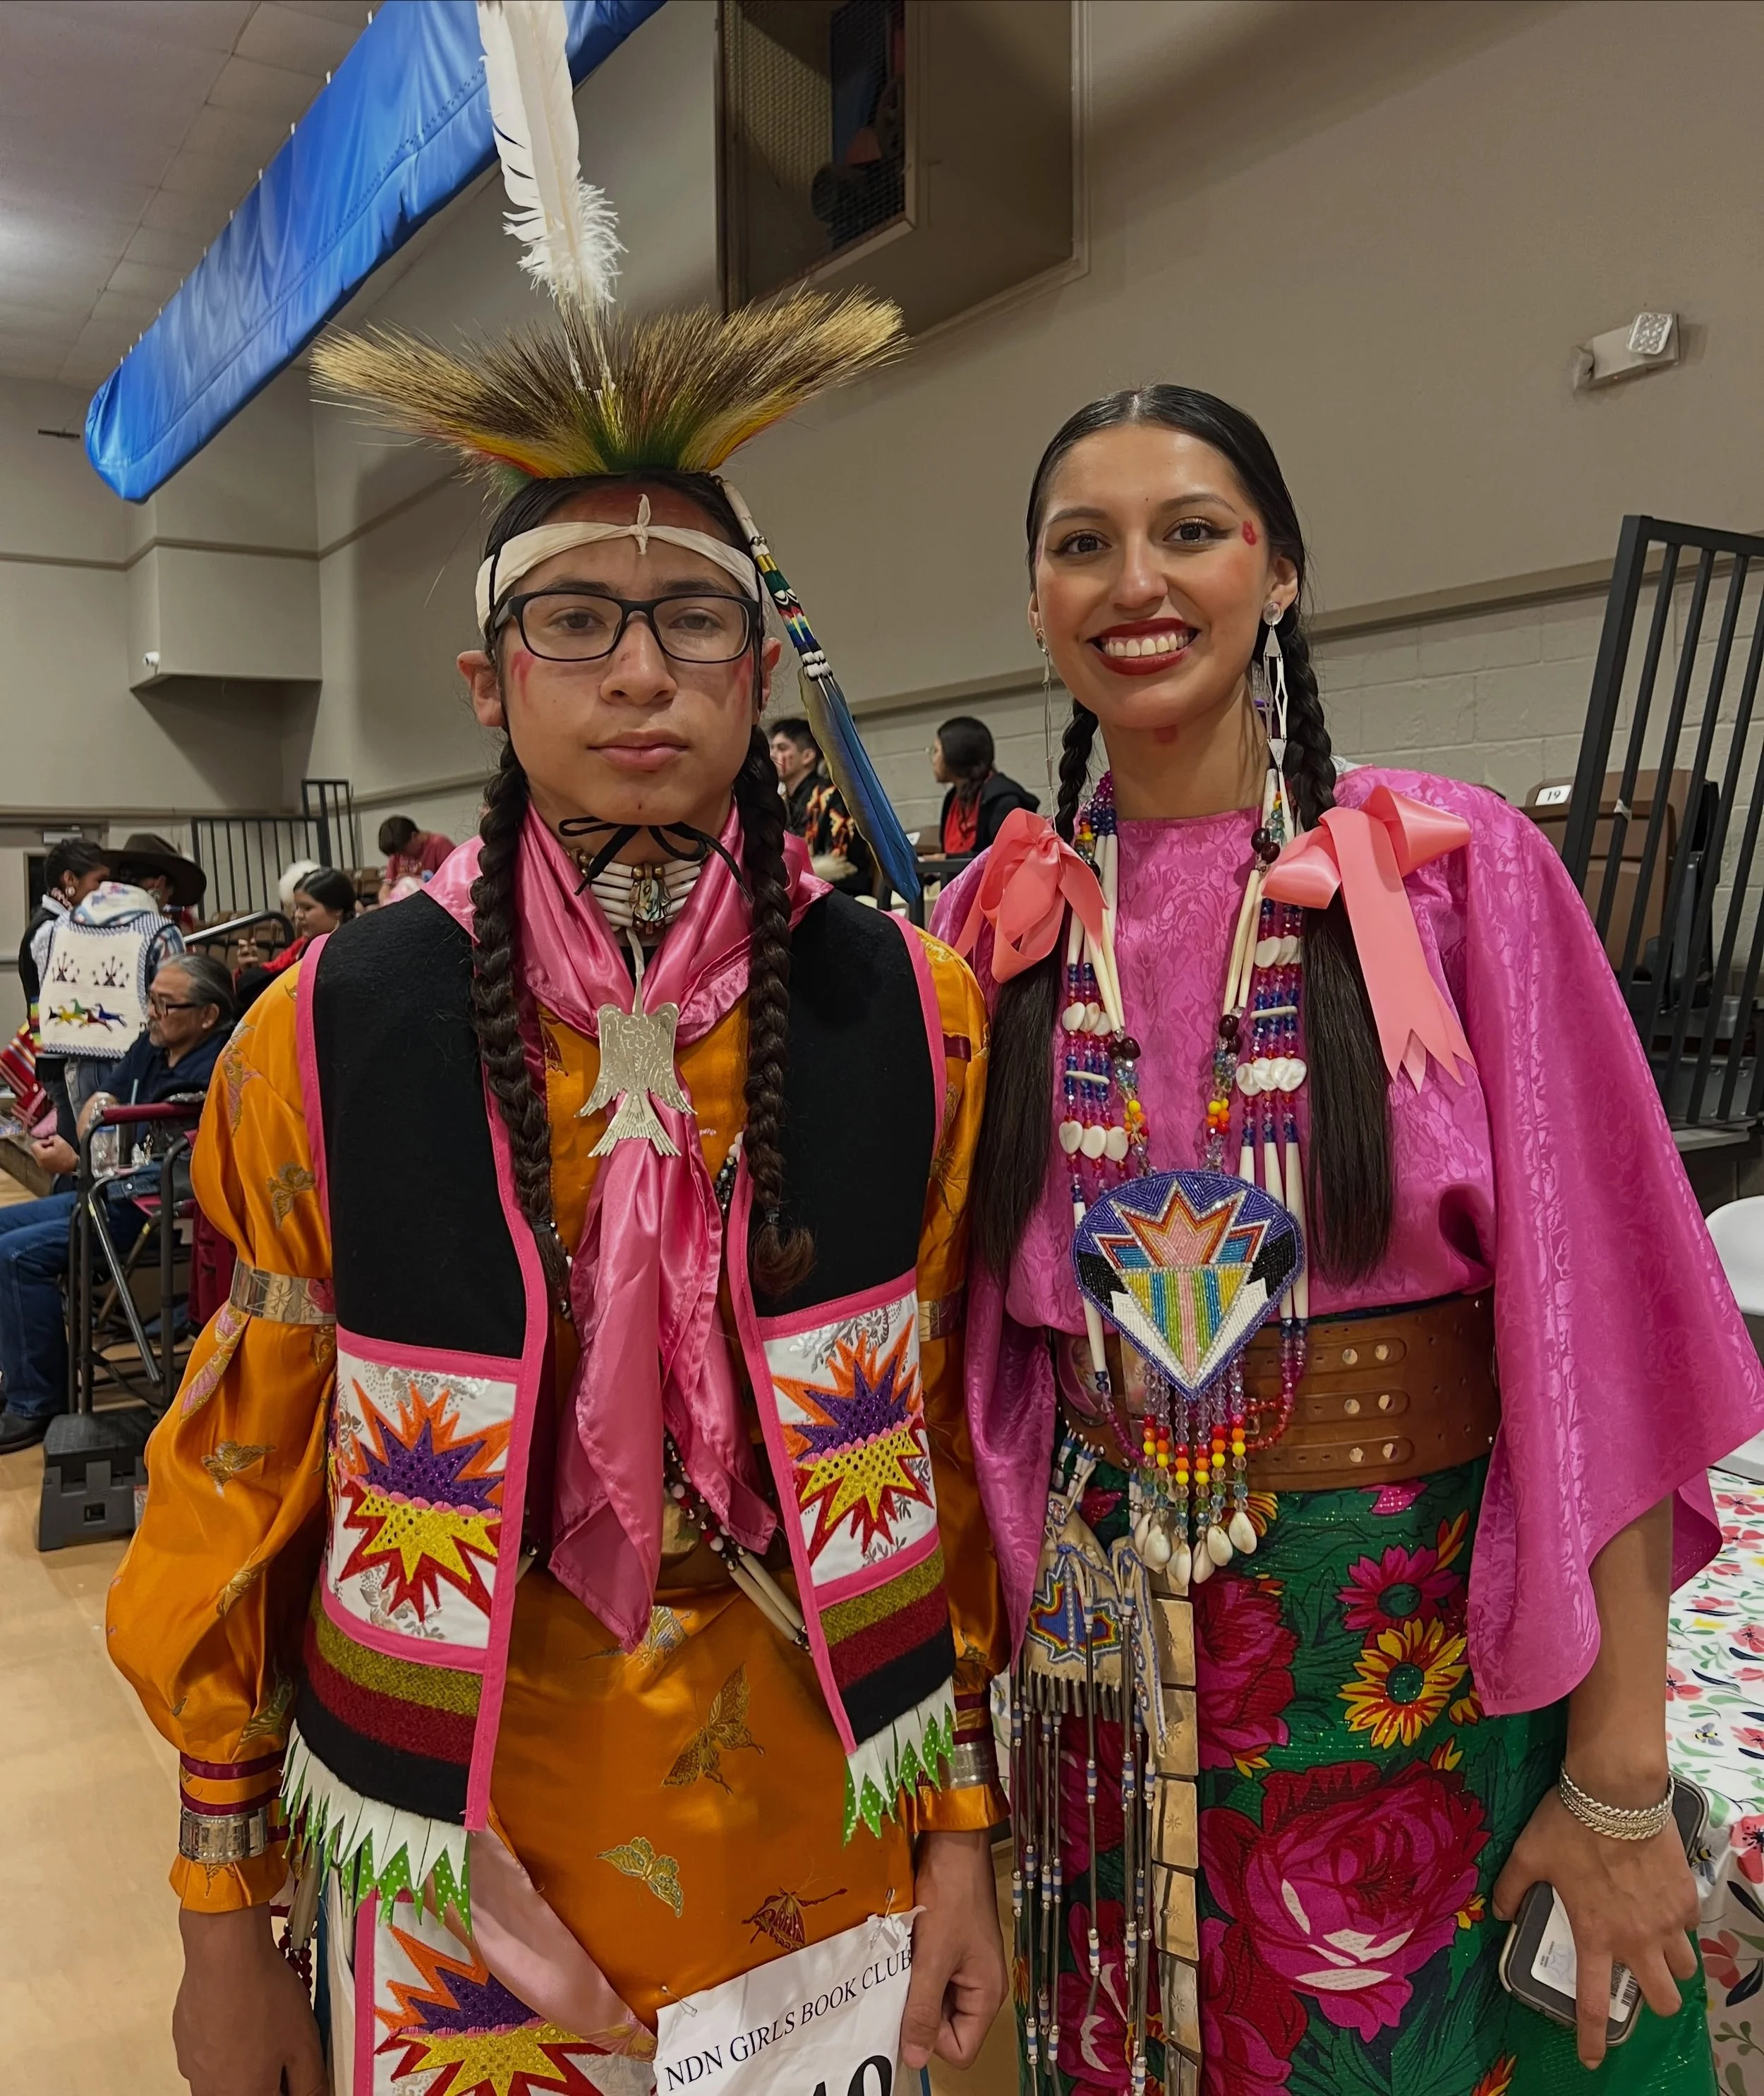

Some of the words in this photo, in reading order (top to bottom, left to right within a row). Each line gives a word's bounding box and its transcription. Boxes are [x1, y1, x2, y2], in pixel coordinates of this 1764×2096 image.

[1547, 790, 1561, 802] 19
[664, 2044, 723, 2092] NDN
[730, 2011, 795, 2062] GIRLS
[799, 1977, 857, 2026] BOOK
[862, 1949, 911, 1990] CLUB
